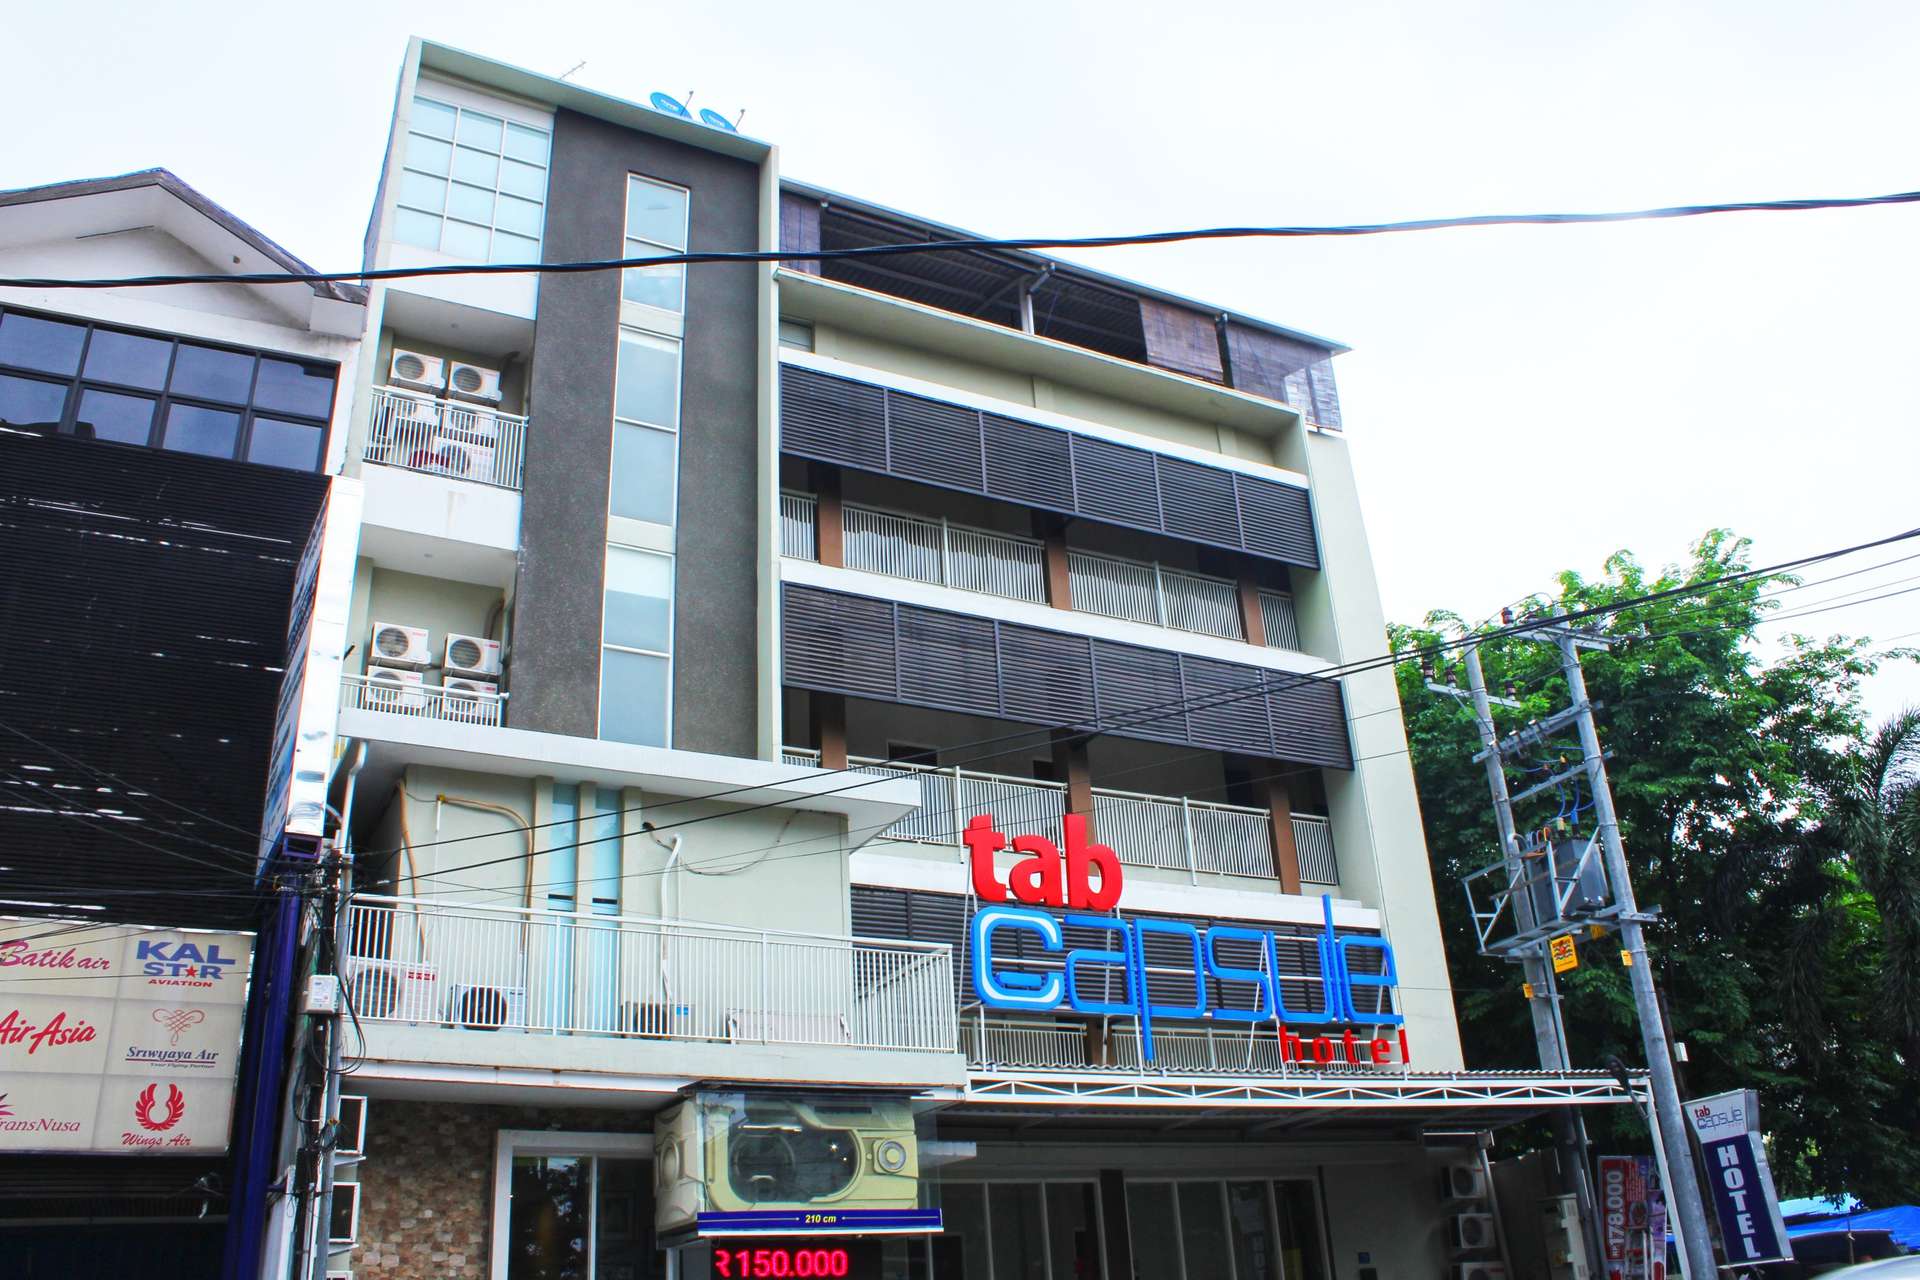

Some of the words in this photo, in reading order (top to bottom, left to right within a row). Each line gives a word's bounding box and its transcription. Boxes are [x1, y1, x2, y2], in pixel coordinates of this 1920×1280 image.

[963, 813, 1123, 912] tab
[136, 940, 236, 965] KAL
[74, 957, 112, 971] air
[148, 978, 213, 988] AVIATION
[1279, 1024, 1410, 1064] hotel
[194, 1049, 219, 1060] Air
[1694, 1105, 1711, 1118] tab
[0, 1118, 81, 1132] ransNusa
[121, 1132, 163, 1150] Wings
[166, 1133, 192, 1146] Air
[1716, 1144, 1761, 1259] HOTEL
[805, 1214, 821, 1224] 210
[822, 1215, 837, 1224] cm
